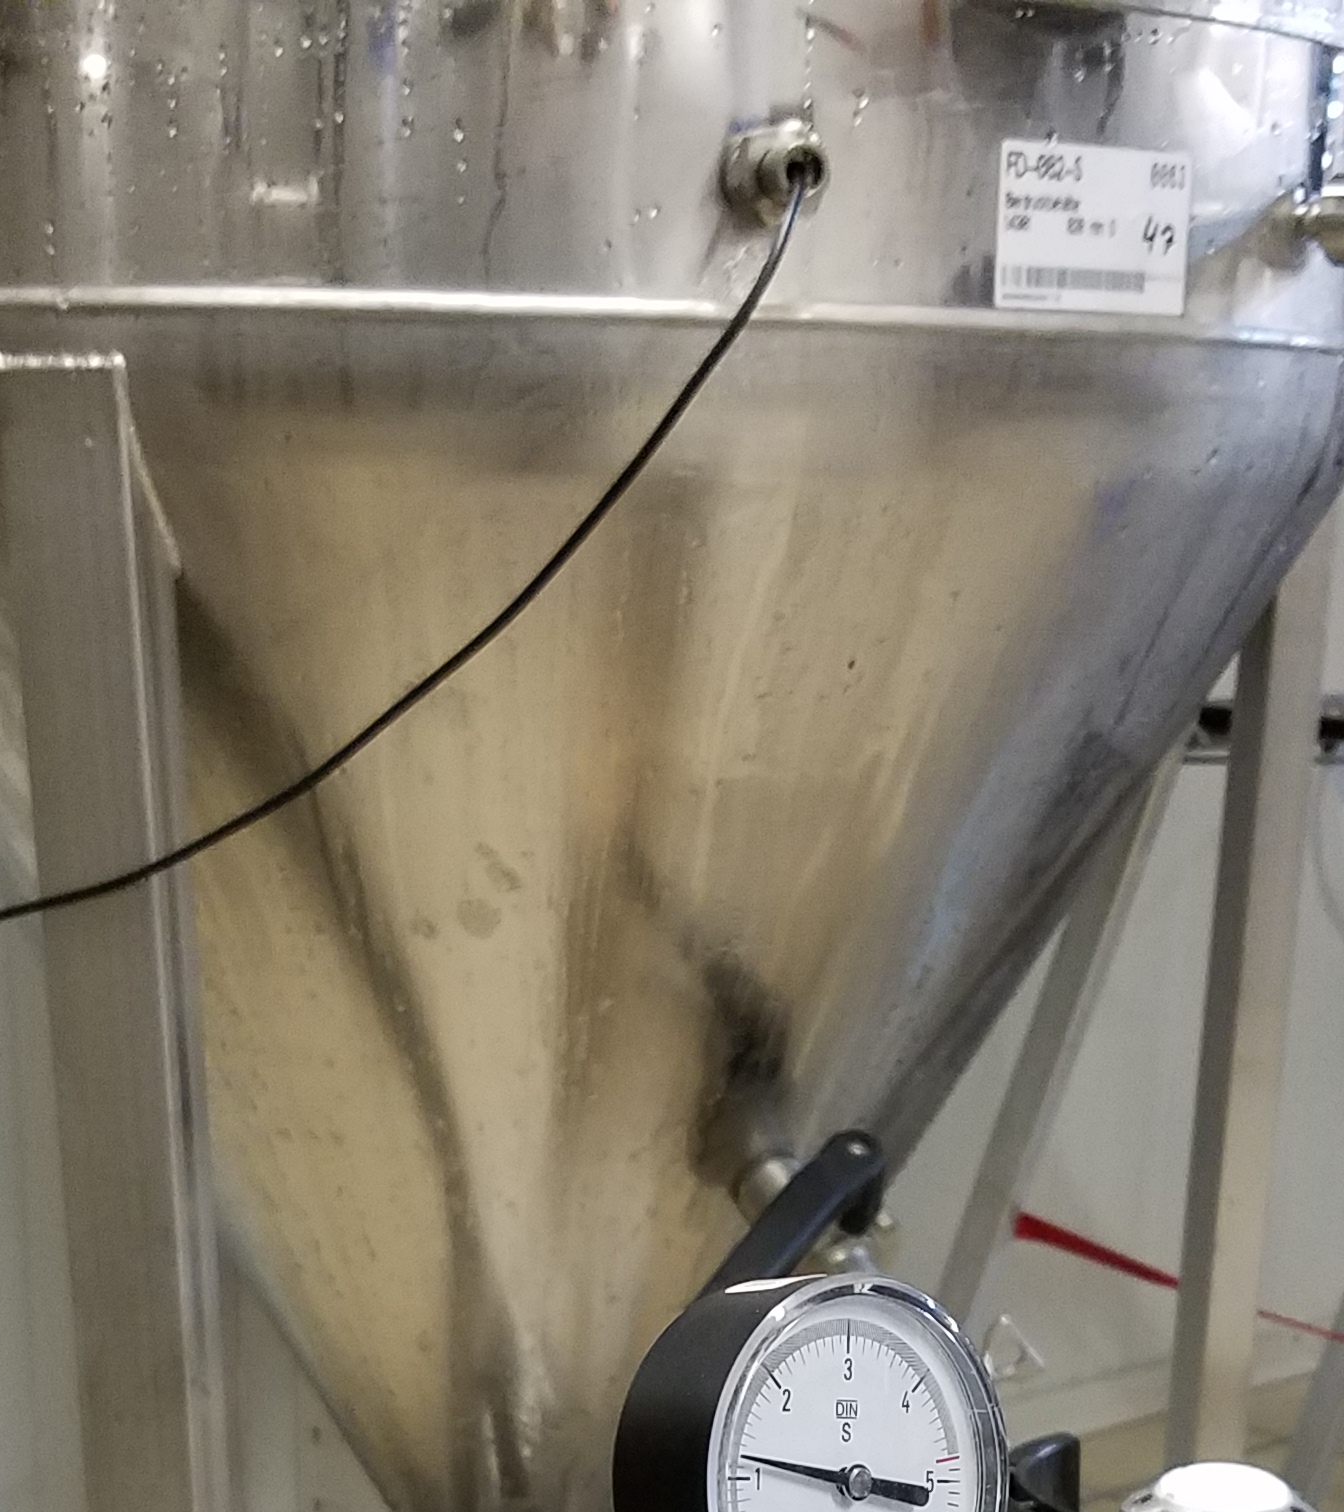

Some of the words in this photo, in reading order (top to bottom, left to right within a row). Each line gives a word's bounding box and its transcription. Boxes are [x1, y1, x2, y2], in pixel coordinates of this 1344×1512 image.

[843, 1359, 853, 1381] 3
[781, 1389, 791, 1413] 2
[836, 1401, 859, 1418] DIN
[901, 1392, 911, 1414] 4
[841, 1423, 851, 1443] S
[754, 1469, 761, 1490] 1
[925, 1471, 935, 1493] 5
